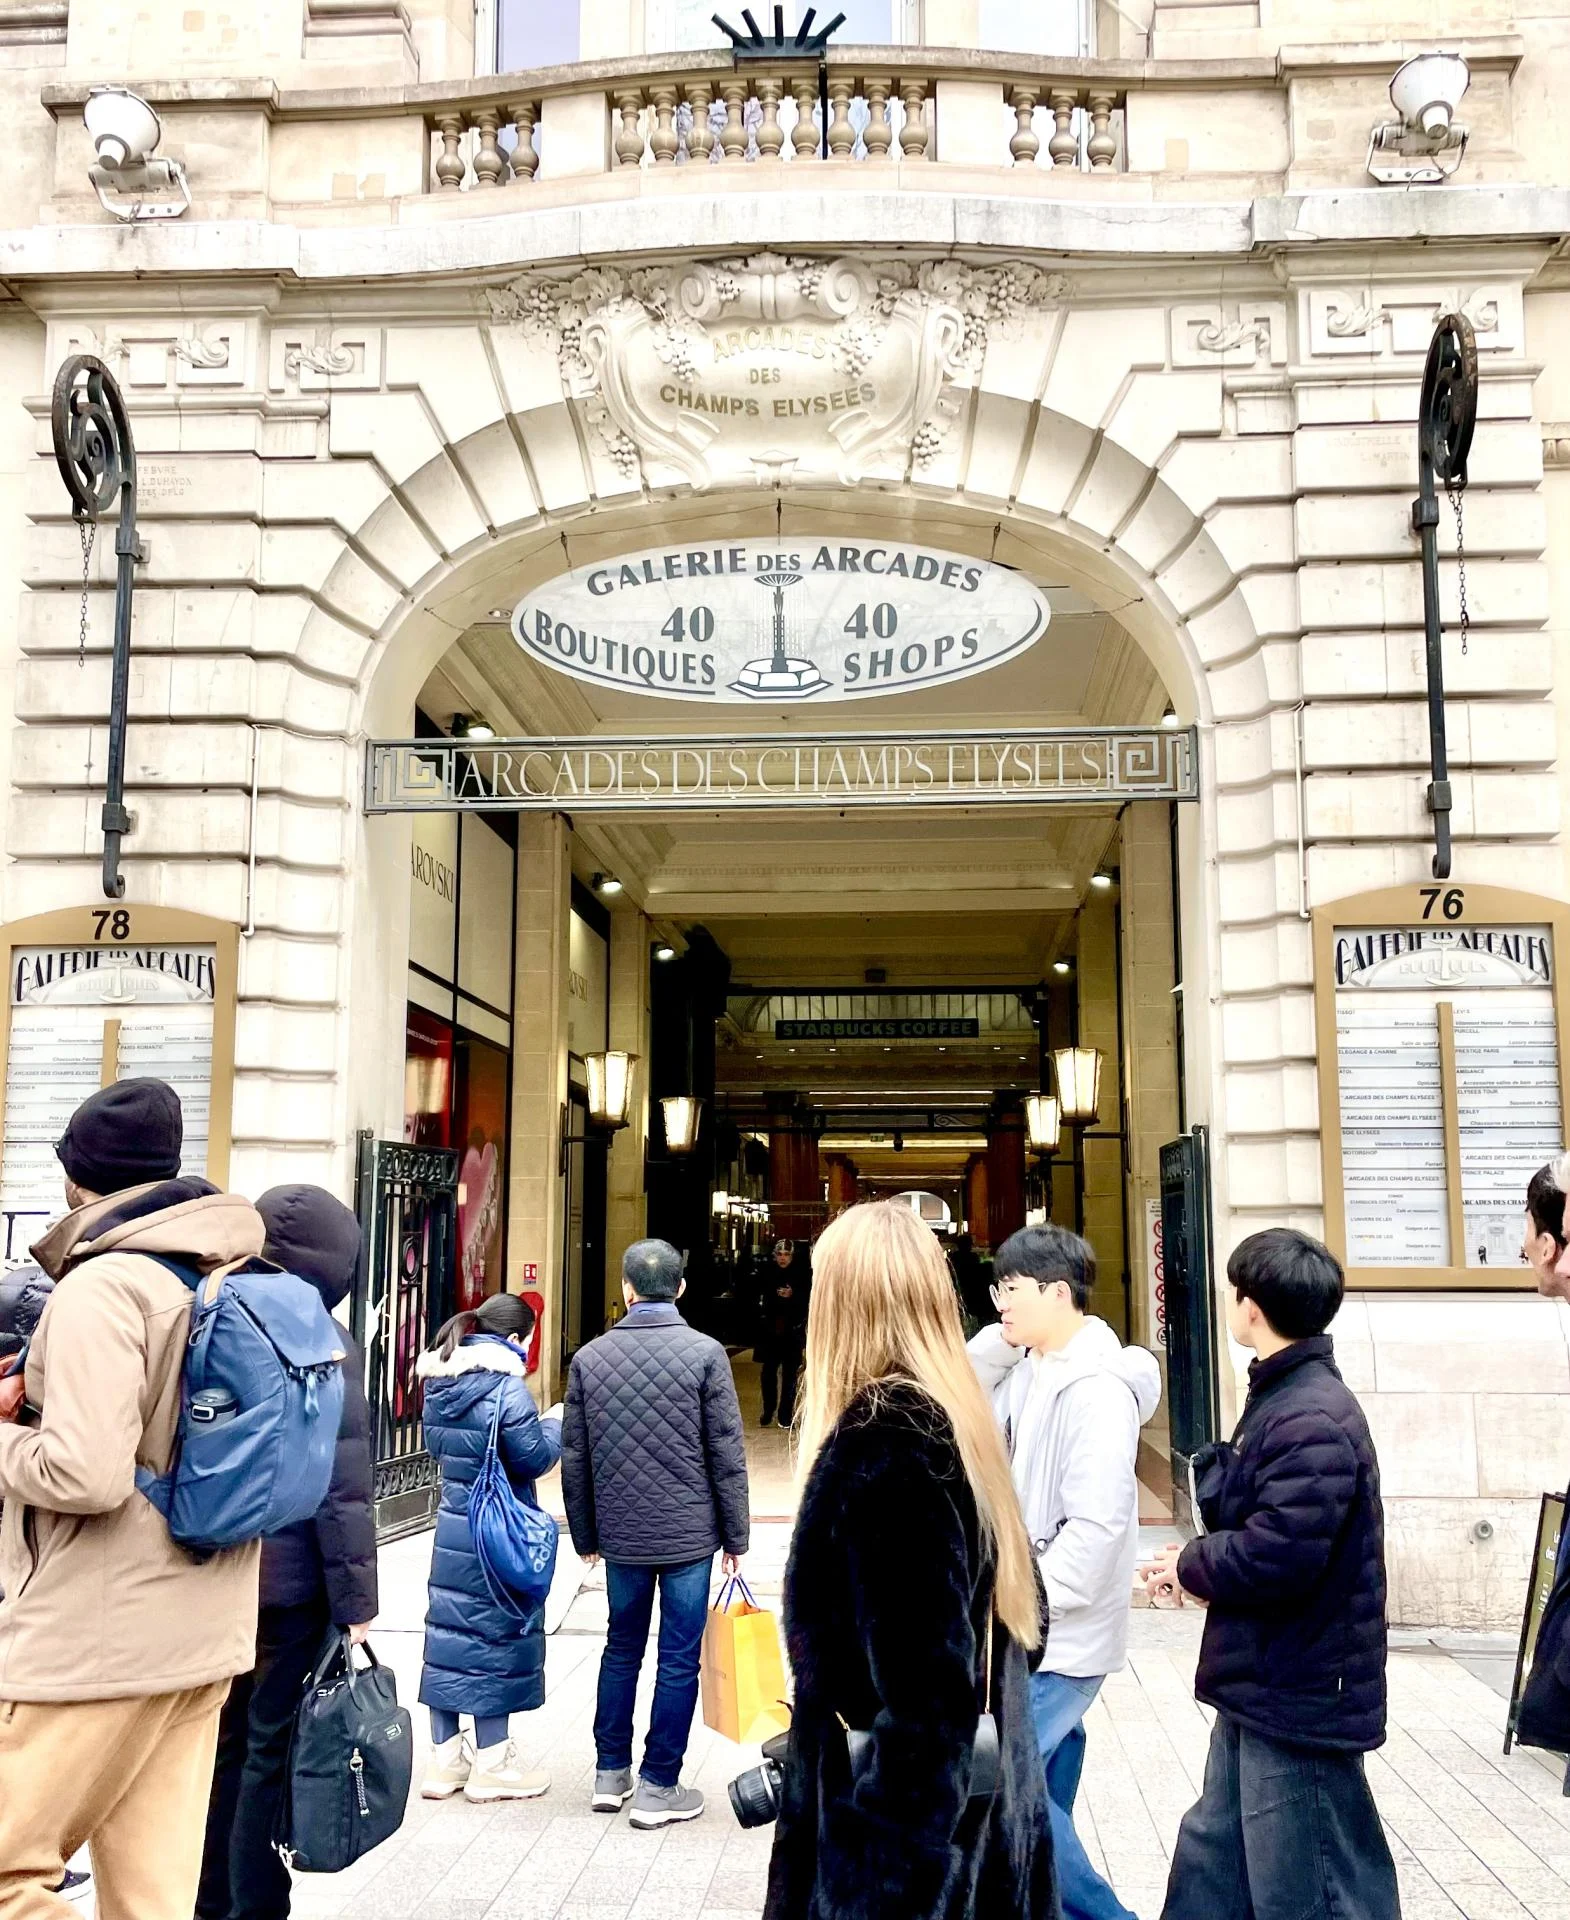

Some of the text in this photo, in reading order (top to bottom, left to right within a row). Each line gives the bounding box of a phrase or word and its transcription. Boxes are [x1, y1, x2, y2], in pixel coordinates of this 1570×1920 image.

[712, 325, 827, 363] ARCADES
[749, 367, 781, 384] DES
[659, 382, 876, 417] CHAMPS ELYSEES
[587, 546, 983, 596] GALERIE DES ARCADES
[661, 603, 898, 642] 40 40
[535, 609, 979, 688] BOUTIQUES SHOPS
[457, 742, 1102, 797] ARCADES DES CHAMPS ELYSEES
[1419, 889, 1465, 920] 76
[92, 910, 130, 940] 78
[783, 1021, 972, 1036] STARBUCKS COFFEE
